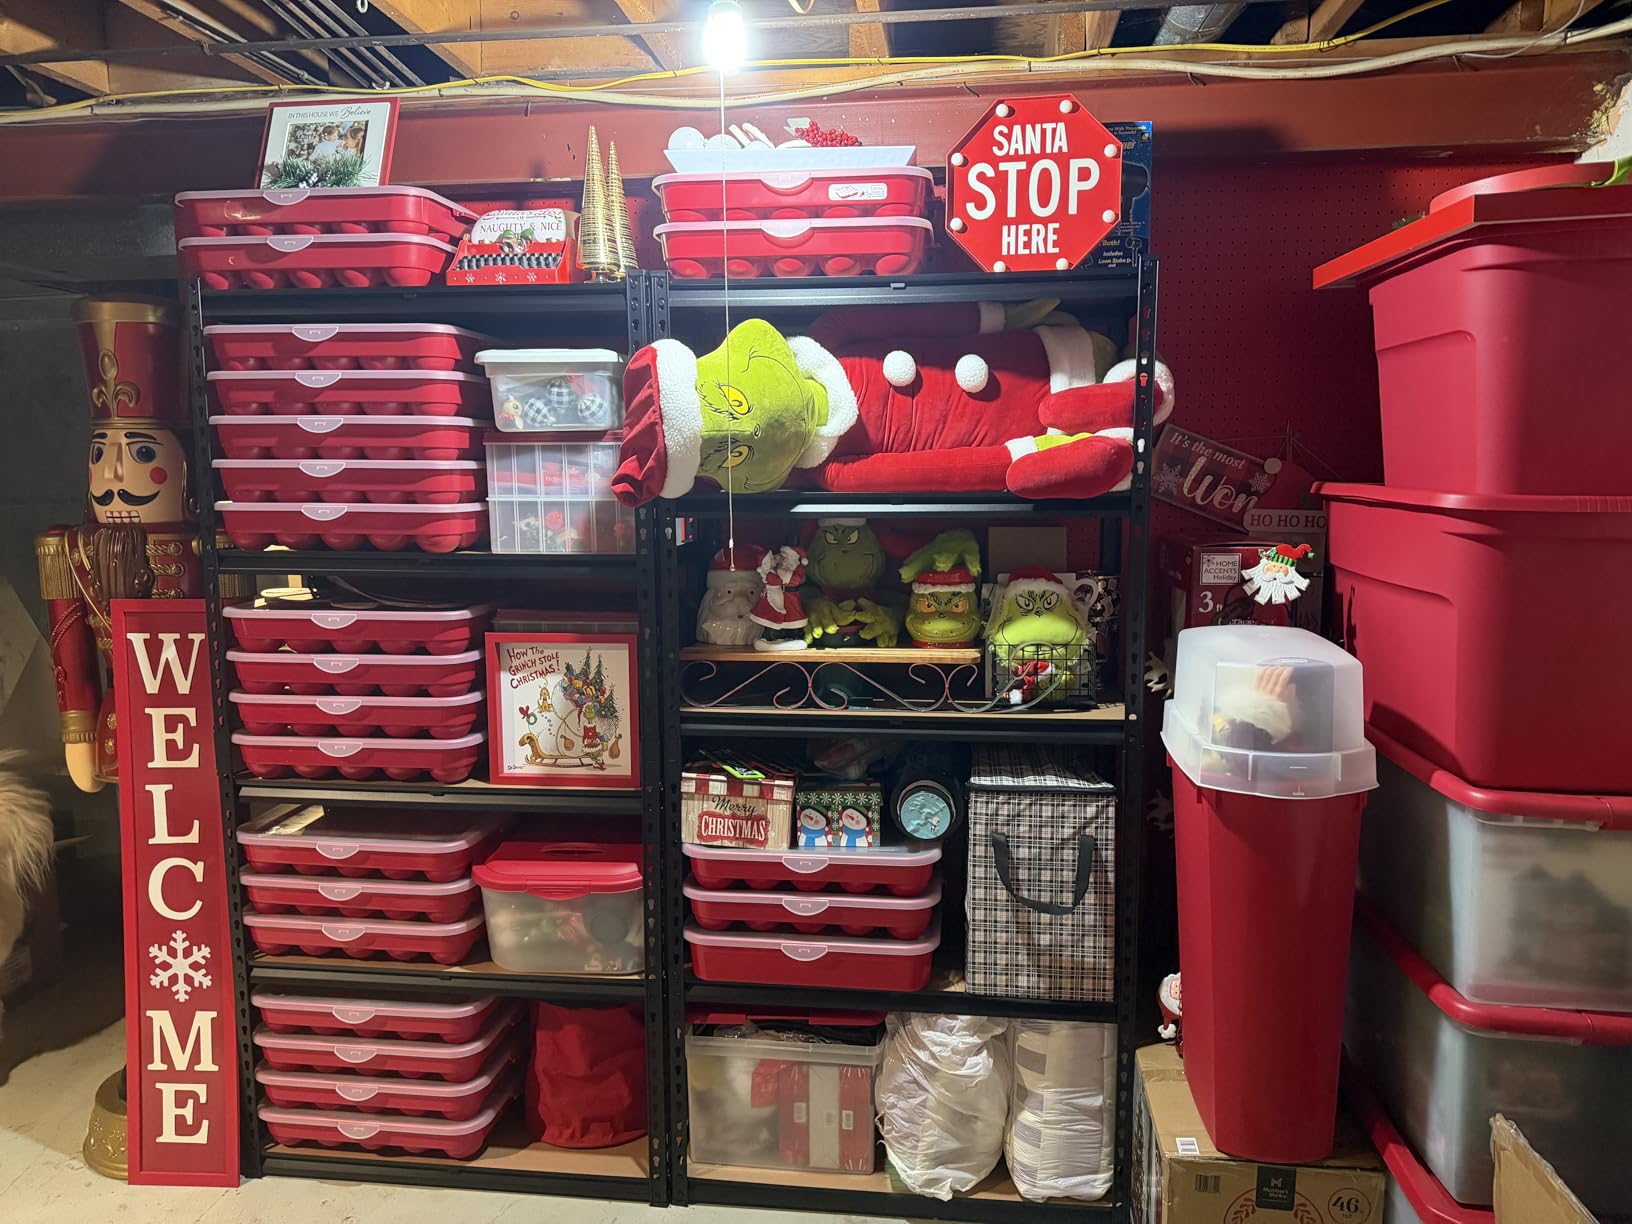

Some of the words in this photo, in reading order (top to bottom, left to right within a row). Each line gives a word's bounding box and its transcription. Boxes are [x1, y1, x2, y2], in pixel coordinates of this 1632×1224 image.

[340, 105, 371, 119] Believe
[992, 122, 1068, 156] SANTA
[965, 158, 1100, 220] STOP
[480, 222, 526, 234] NAUGHTY
[529, 222, 536, 231] &
[540, 221, 562, 231] NICE
[1001, 223, 1060, 256] HERE
[1170, 432, 1189, 449] It's
[1191, 441, 1211, 456] the
[1213, 453, 1247, 470] most
[1250, 514, 1272, 527] HO
[1277, 514, 1299, 527] HO
[1304, 515, 1326, 528] HO
[1198, 591, 1214, 613] 3
[529, 646, 545, 656] The
[508, 659, 537, 676] GRINCH
[539, 651, 559, 665] STOLE
[712, 795, 757, 818] Merry
[701, 815, 766, 841] CHRISTMAS
[1331, 1195, 1360, 1215] 46
